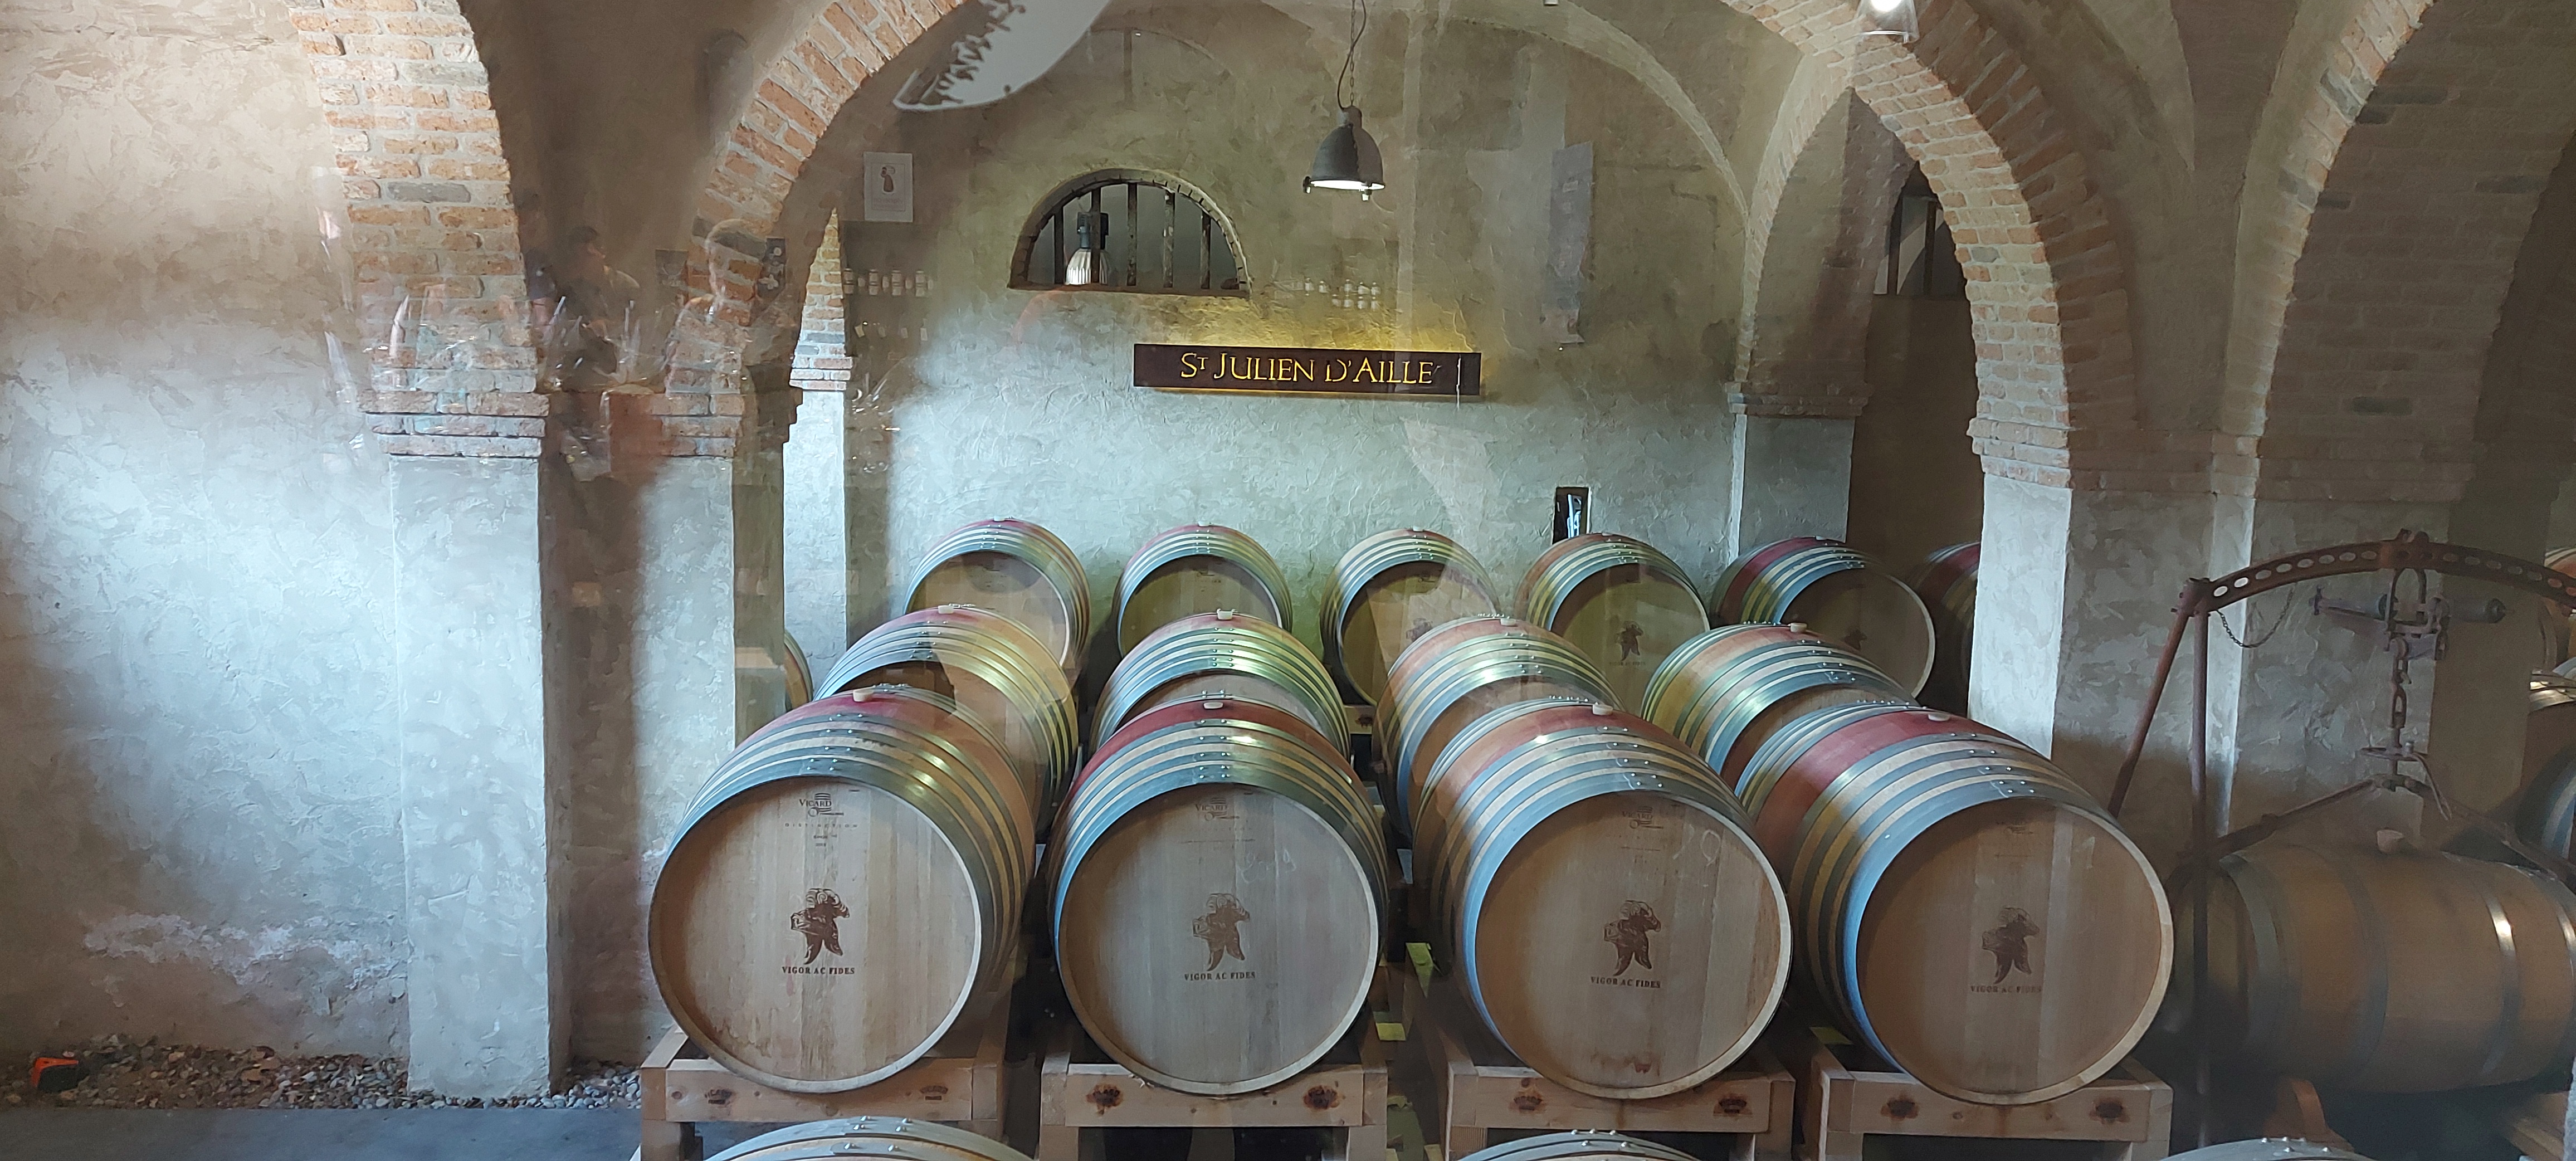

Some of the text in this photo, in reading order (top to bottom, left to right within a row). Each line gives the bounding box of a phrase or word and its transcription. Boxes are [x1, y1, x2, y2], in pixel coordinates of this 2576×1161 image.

[1213, 353, 1315, 382] JULIEN
[1325, 357, 1433, 384] D'AILLE
[1184, 973, 1212, 981] VIGOR
[1230, 971, 1256, 979] FIDES
[1591, 976, 1618, 986] VIGOR
